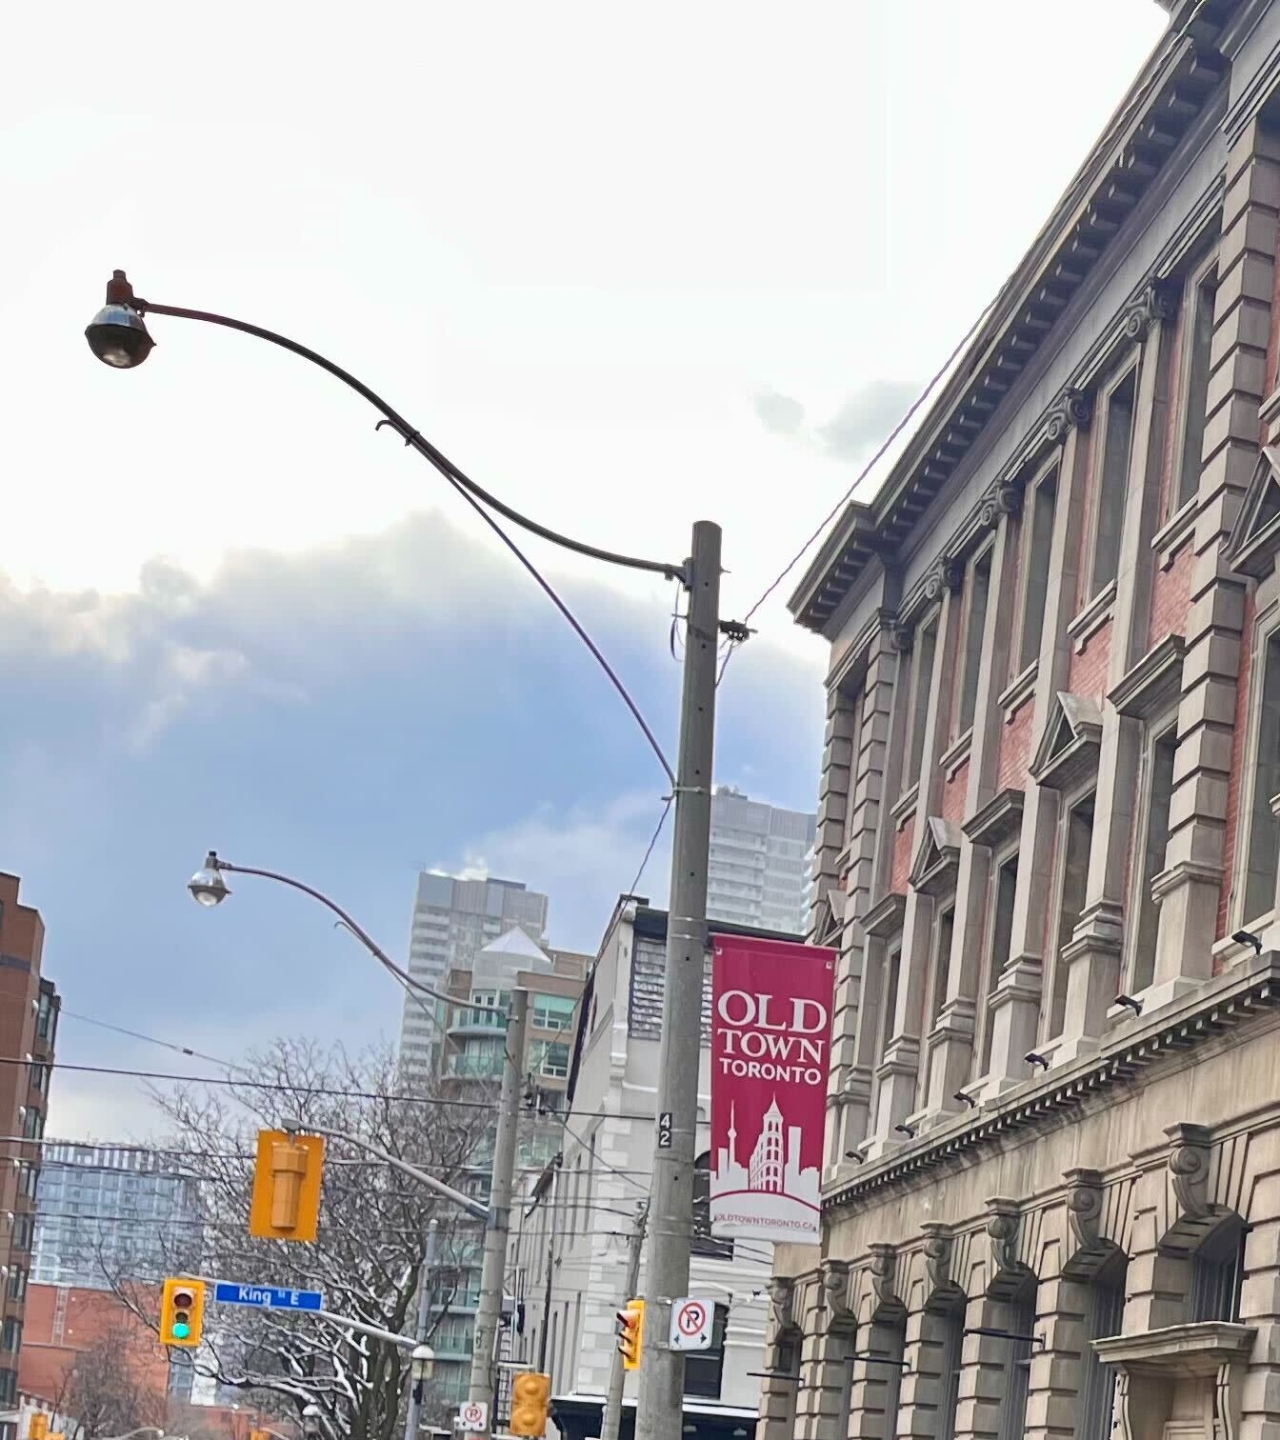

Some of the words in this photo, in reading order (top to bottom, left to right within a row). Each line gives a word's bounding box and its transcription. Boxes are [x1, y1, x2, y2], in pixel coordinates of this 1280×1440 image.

[718, 990, 827, 1033] OLD
[717, 1028, 825, 1064] TOWN
[719, 1058, 821, 1085] TORONTO
[238, 1288, 271, 1304] King
[290, 1293, 299, 1305] E
